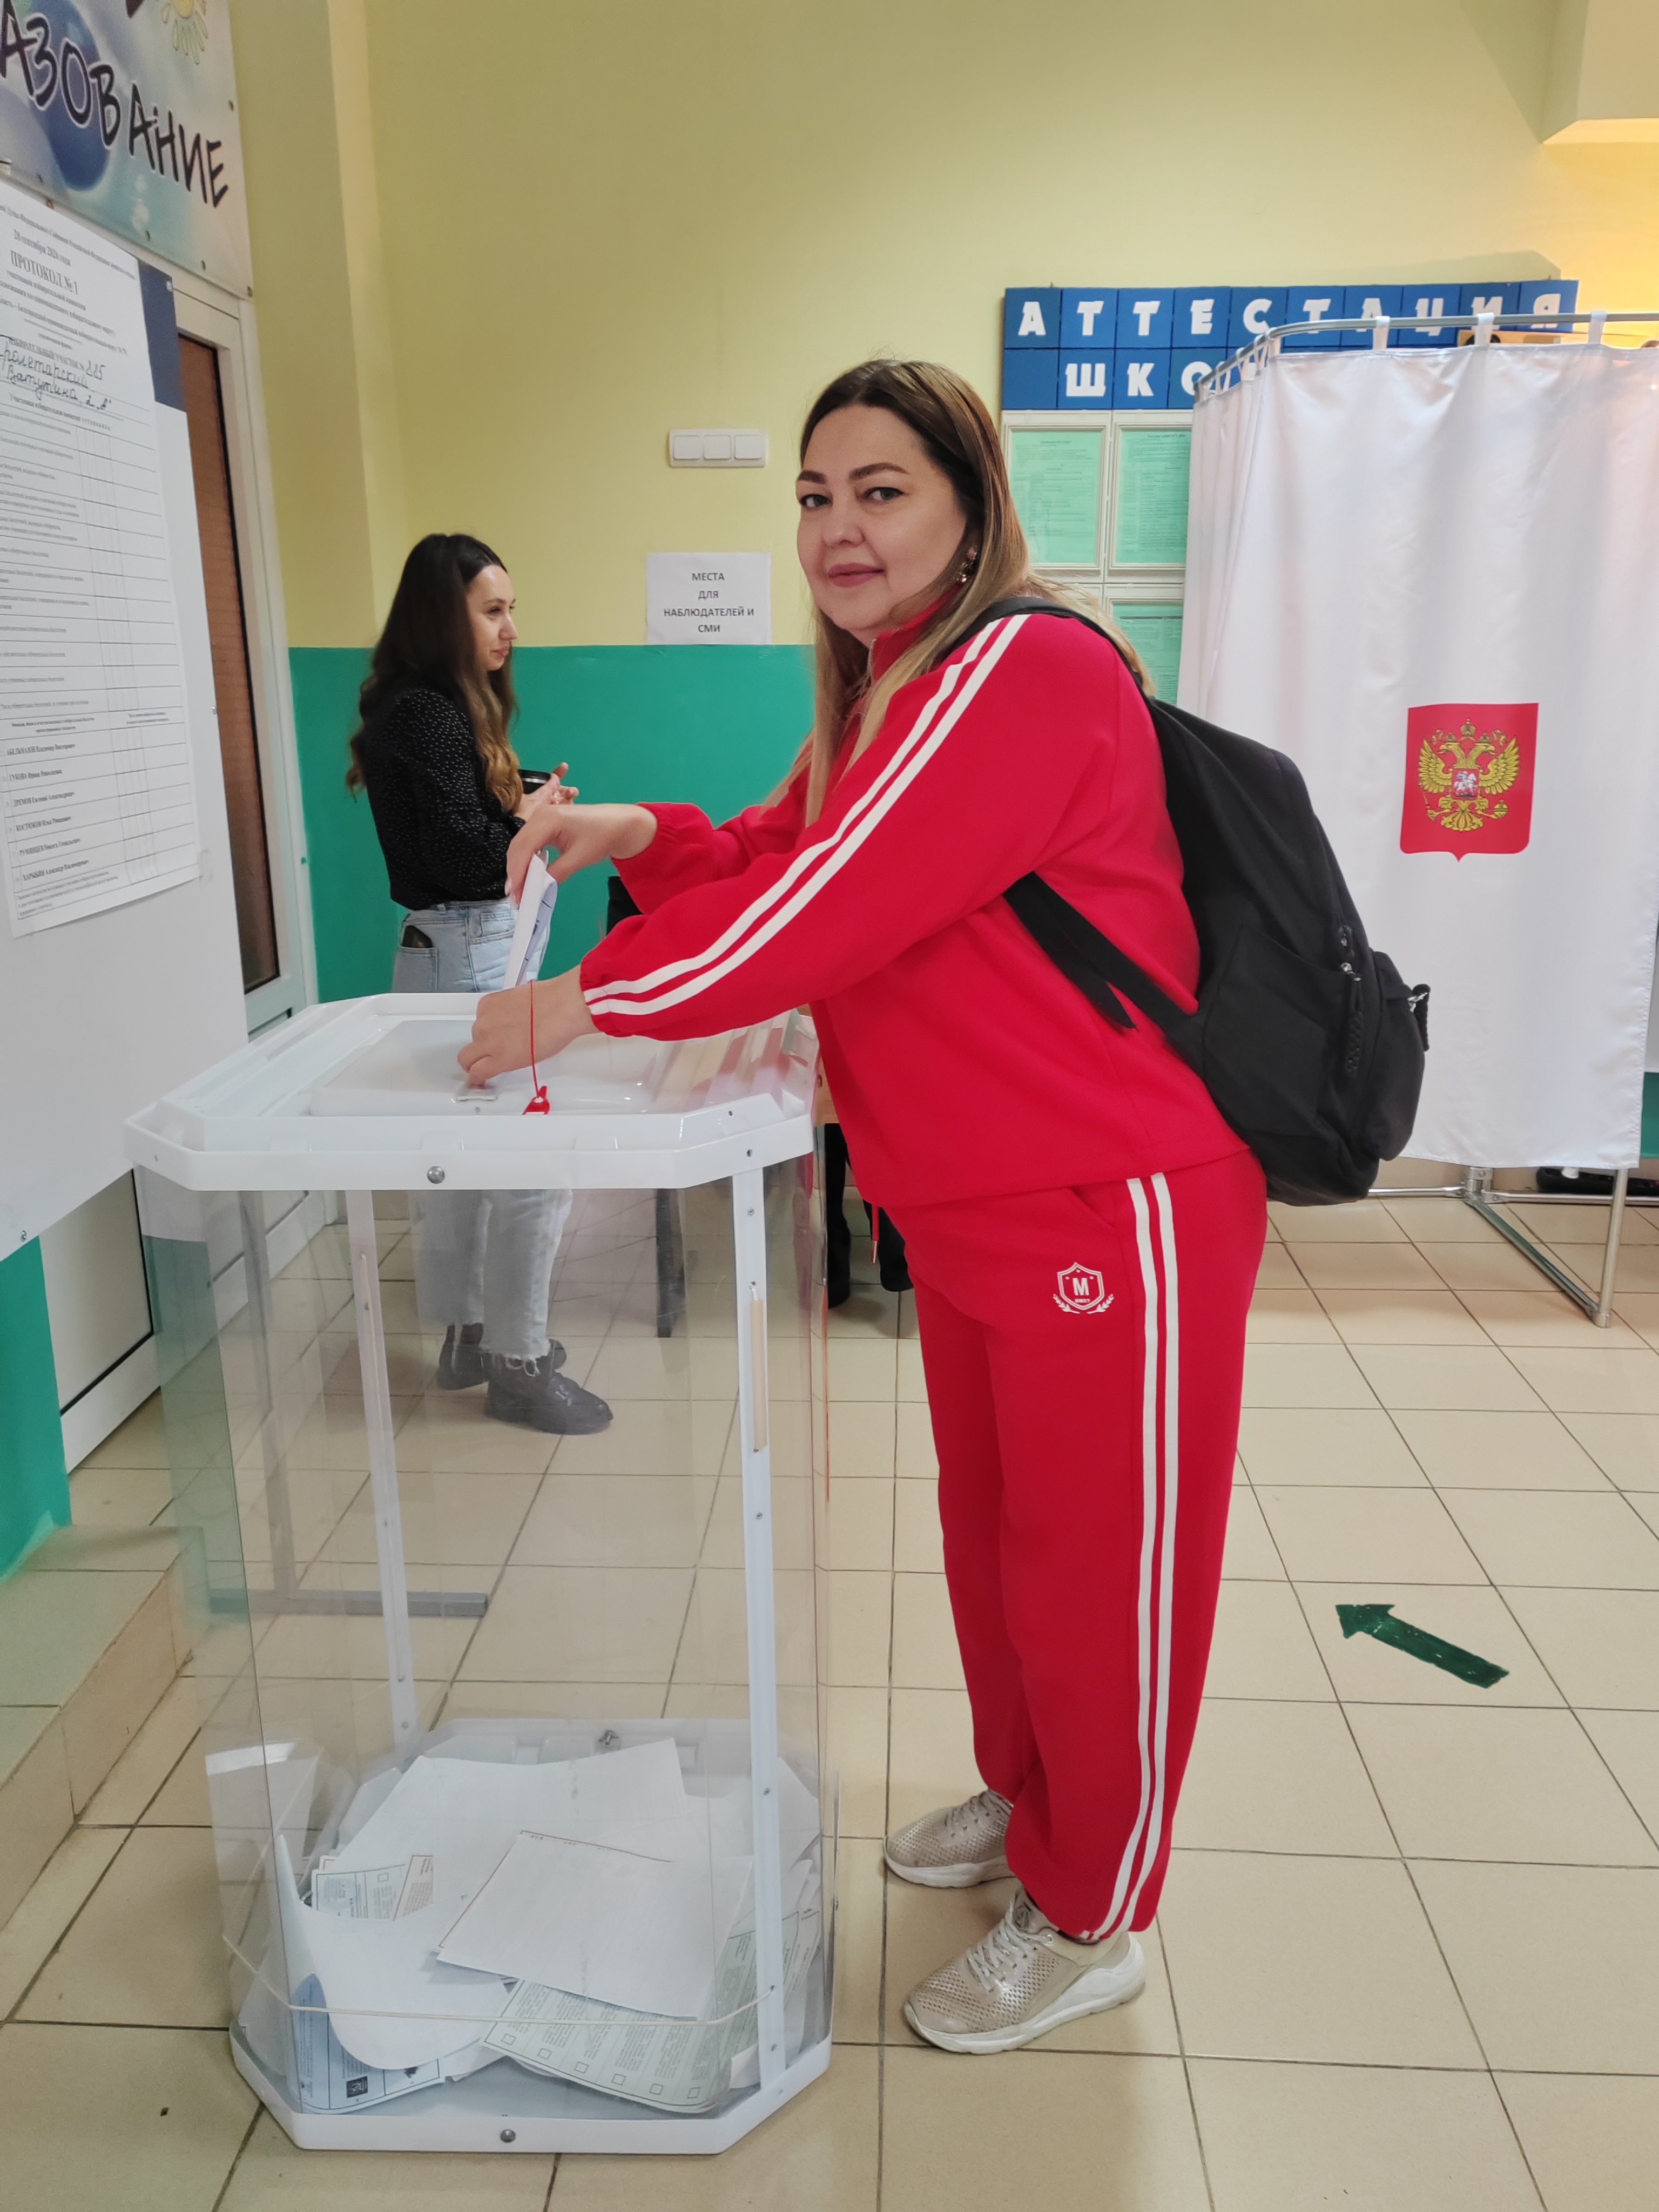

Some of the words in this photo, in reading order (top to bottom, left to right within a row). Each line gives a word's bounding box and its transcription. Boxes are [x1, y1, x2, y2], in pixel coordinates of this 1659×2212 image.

[10, 250, 63, 287] ПРОТОКОЛ
[1018, 293, 1561, 336] АТТЕСТАЦИЯ
[692, 572, 725, 581] МЕСТА
[698, 590, 719, 600] ДЛЯ
[664, 606, 744, 618] НАБЛЮДАТЕЛЕЙ
[747, 608, 754, 616] И
[698, 624, 720, 632] СМИ
[1073, 1278, 1089, 1296] M
